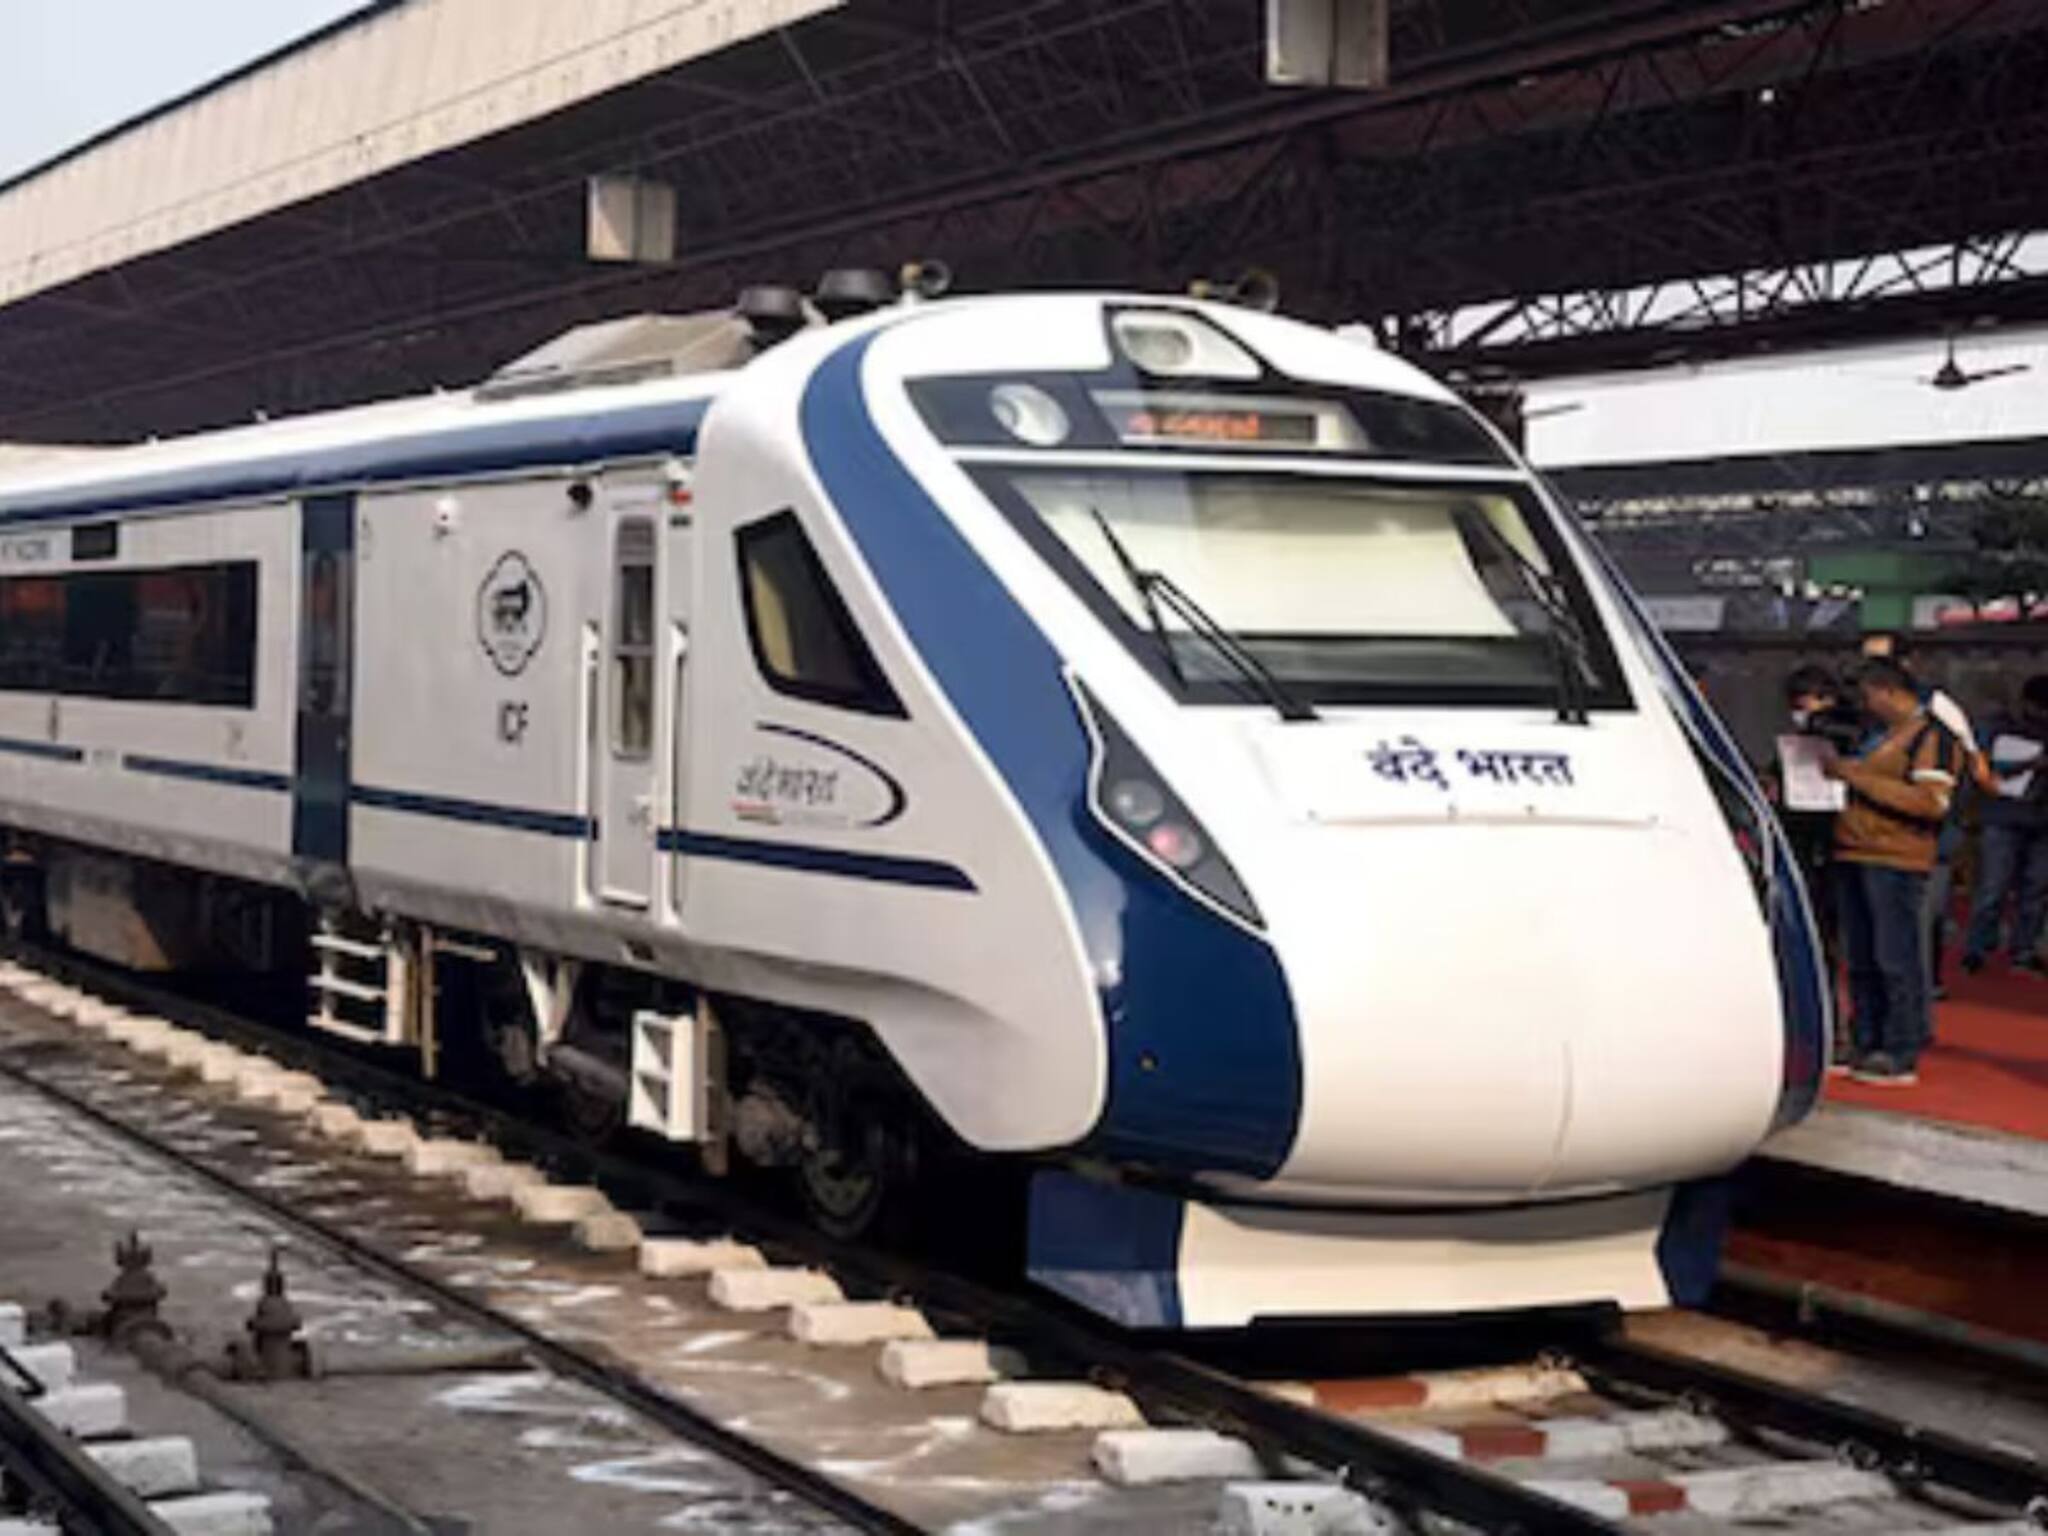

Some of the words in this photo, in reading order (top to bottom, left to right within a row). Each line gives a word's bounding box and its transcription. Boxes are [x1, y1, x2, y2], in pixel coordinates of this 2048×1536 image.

[497, 701, 529, 745] ICF
[1366, 735, 1449, 791] वंदे
[1456, 749, 1575, 786] भारत
